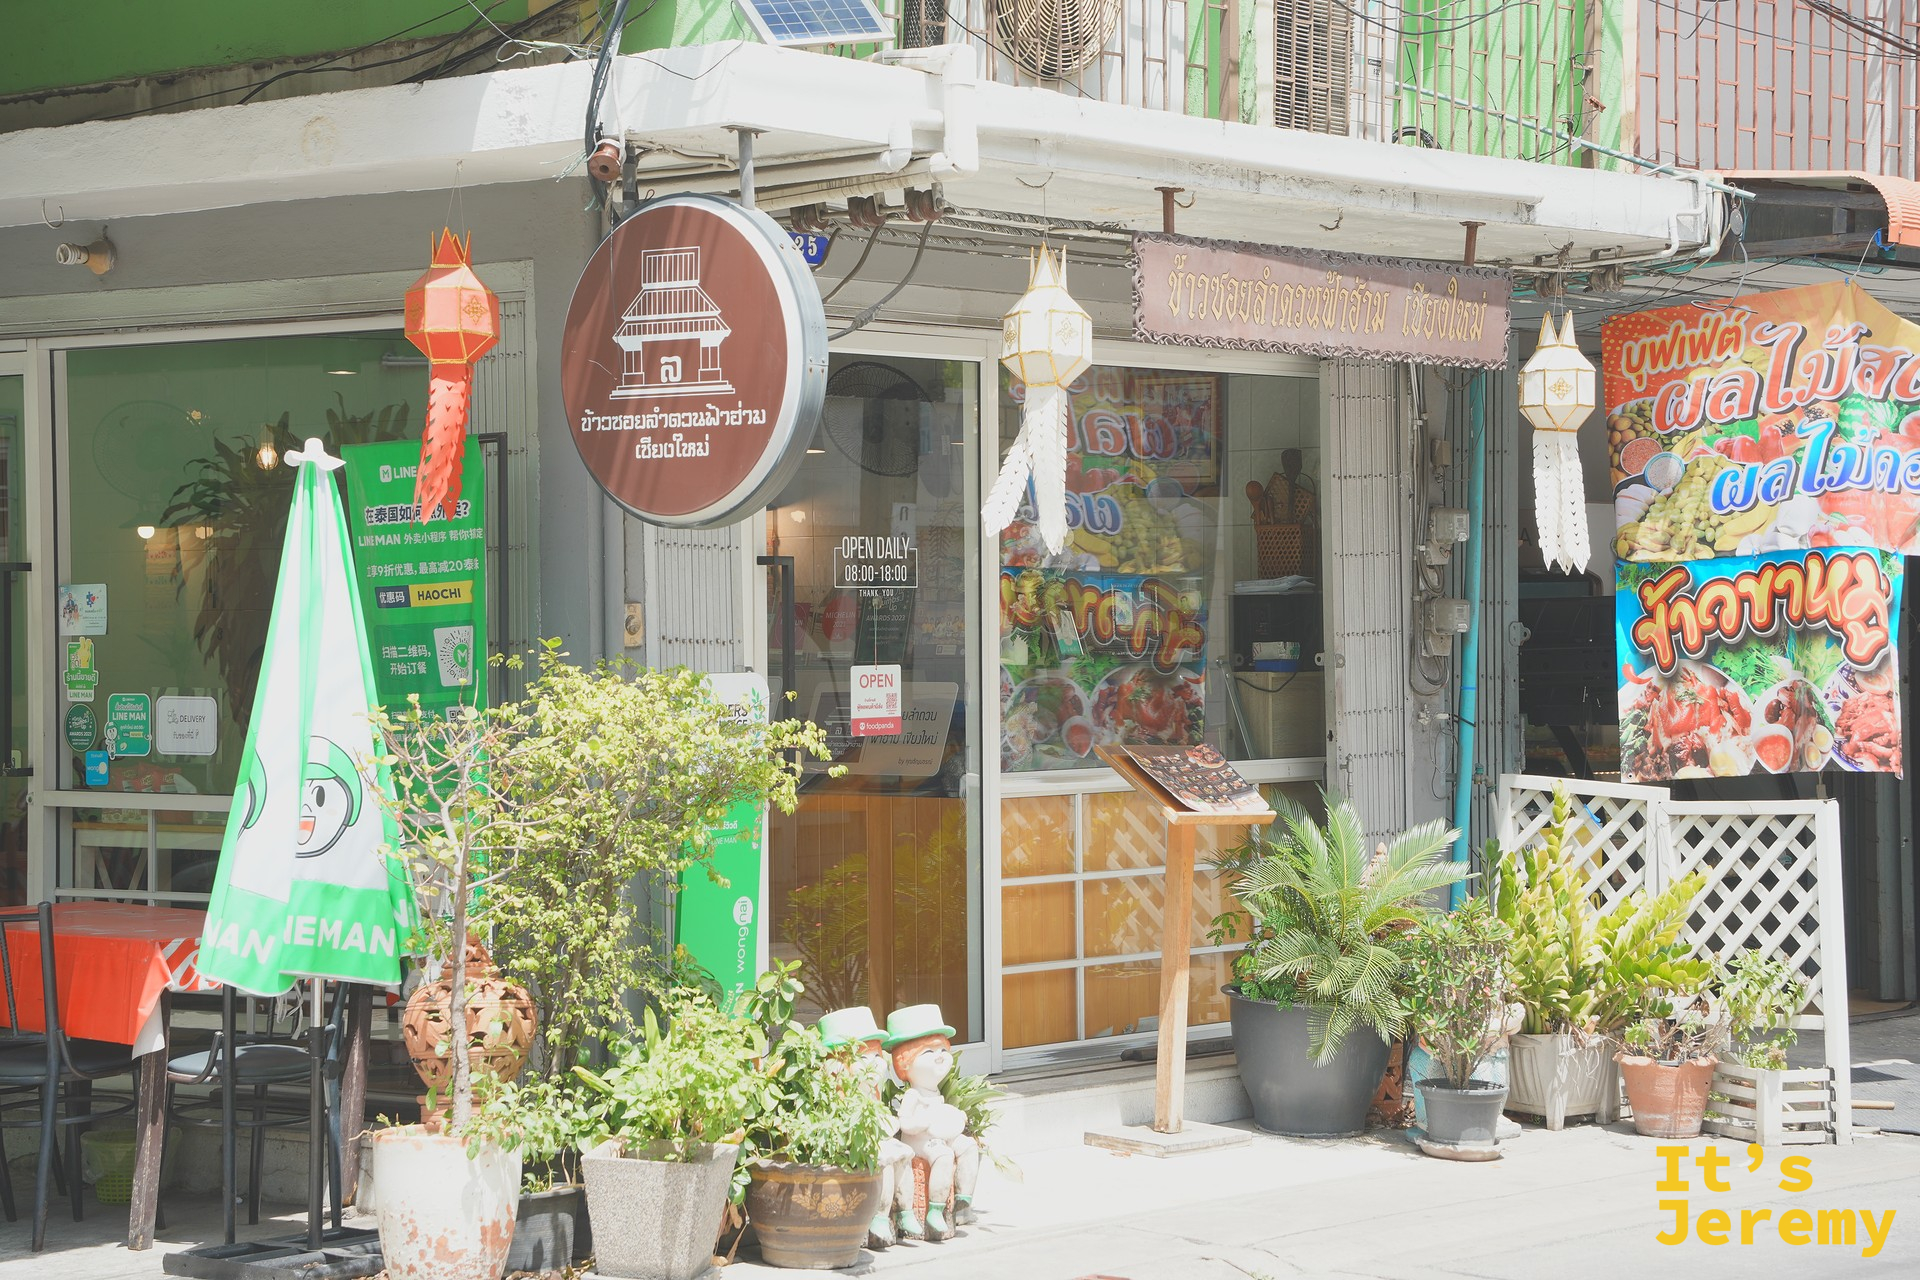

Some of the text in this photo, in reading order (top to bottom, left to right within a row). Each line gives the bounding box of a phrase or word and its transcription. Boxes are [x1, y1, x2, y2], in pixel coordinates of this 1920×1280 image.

[1167, 254, 1488, 343] ข้าวซอยลำดวนฟ้าฮ่าม เชียงใหม่
[1624, 308, 1749, 390] บุฟเฟ่ต์
[581, 401, 767, 432] ข้าวซอยลำดวนฟ้าฮ่าม
[635, 433, 710, 459] เชียงใหม่
[404, 531, 447, 545] 外卖小程序
[842, 537, 910, 559] OPEN DAILY
[844, 564, 908, 582] 08:00-18:00
[379, 588, 461, 603] 优惠码 HAOCHI
[859, 589, 894, 597] THANK YOU
[1632, 553, 1891, 673] ข้าวขาหมู
[390, 662, 427, 675] 开始订餐
[859, 673, 894, 689] OPEN
[112, 712, 146, 721] LINE MAN
[179, 715, 206, 723] DELIVERY
[866, 721, 894, 731] foodpanda
